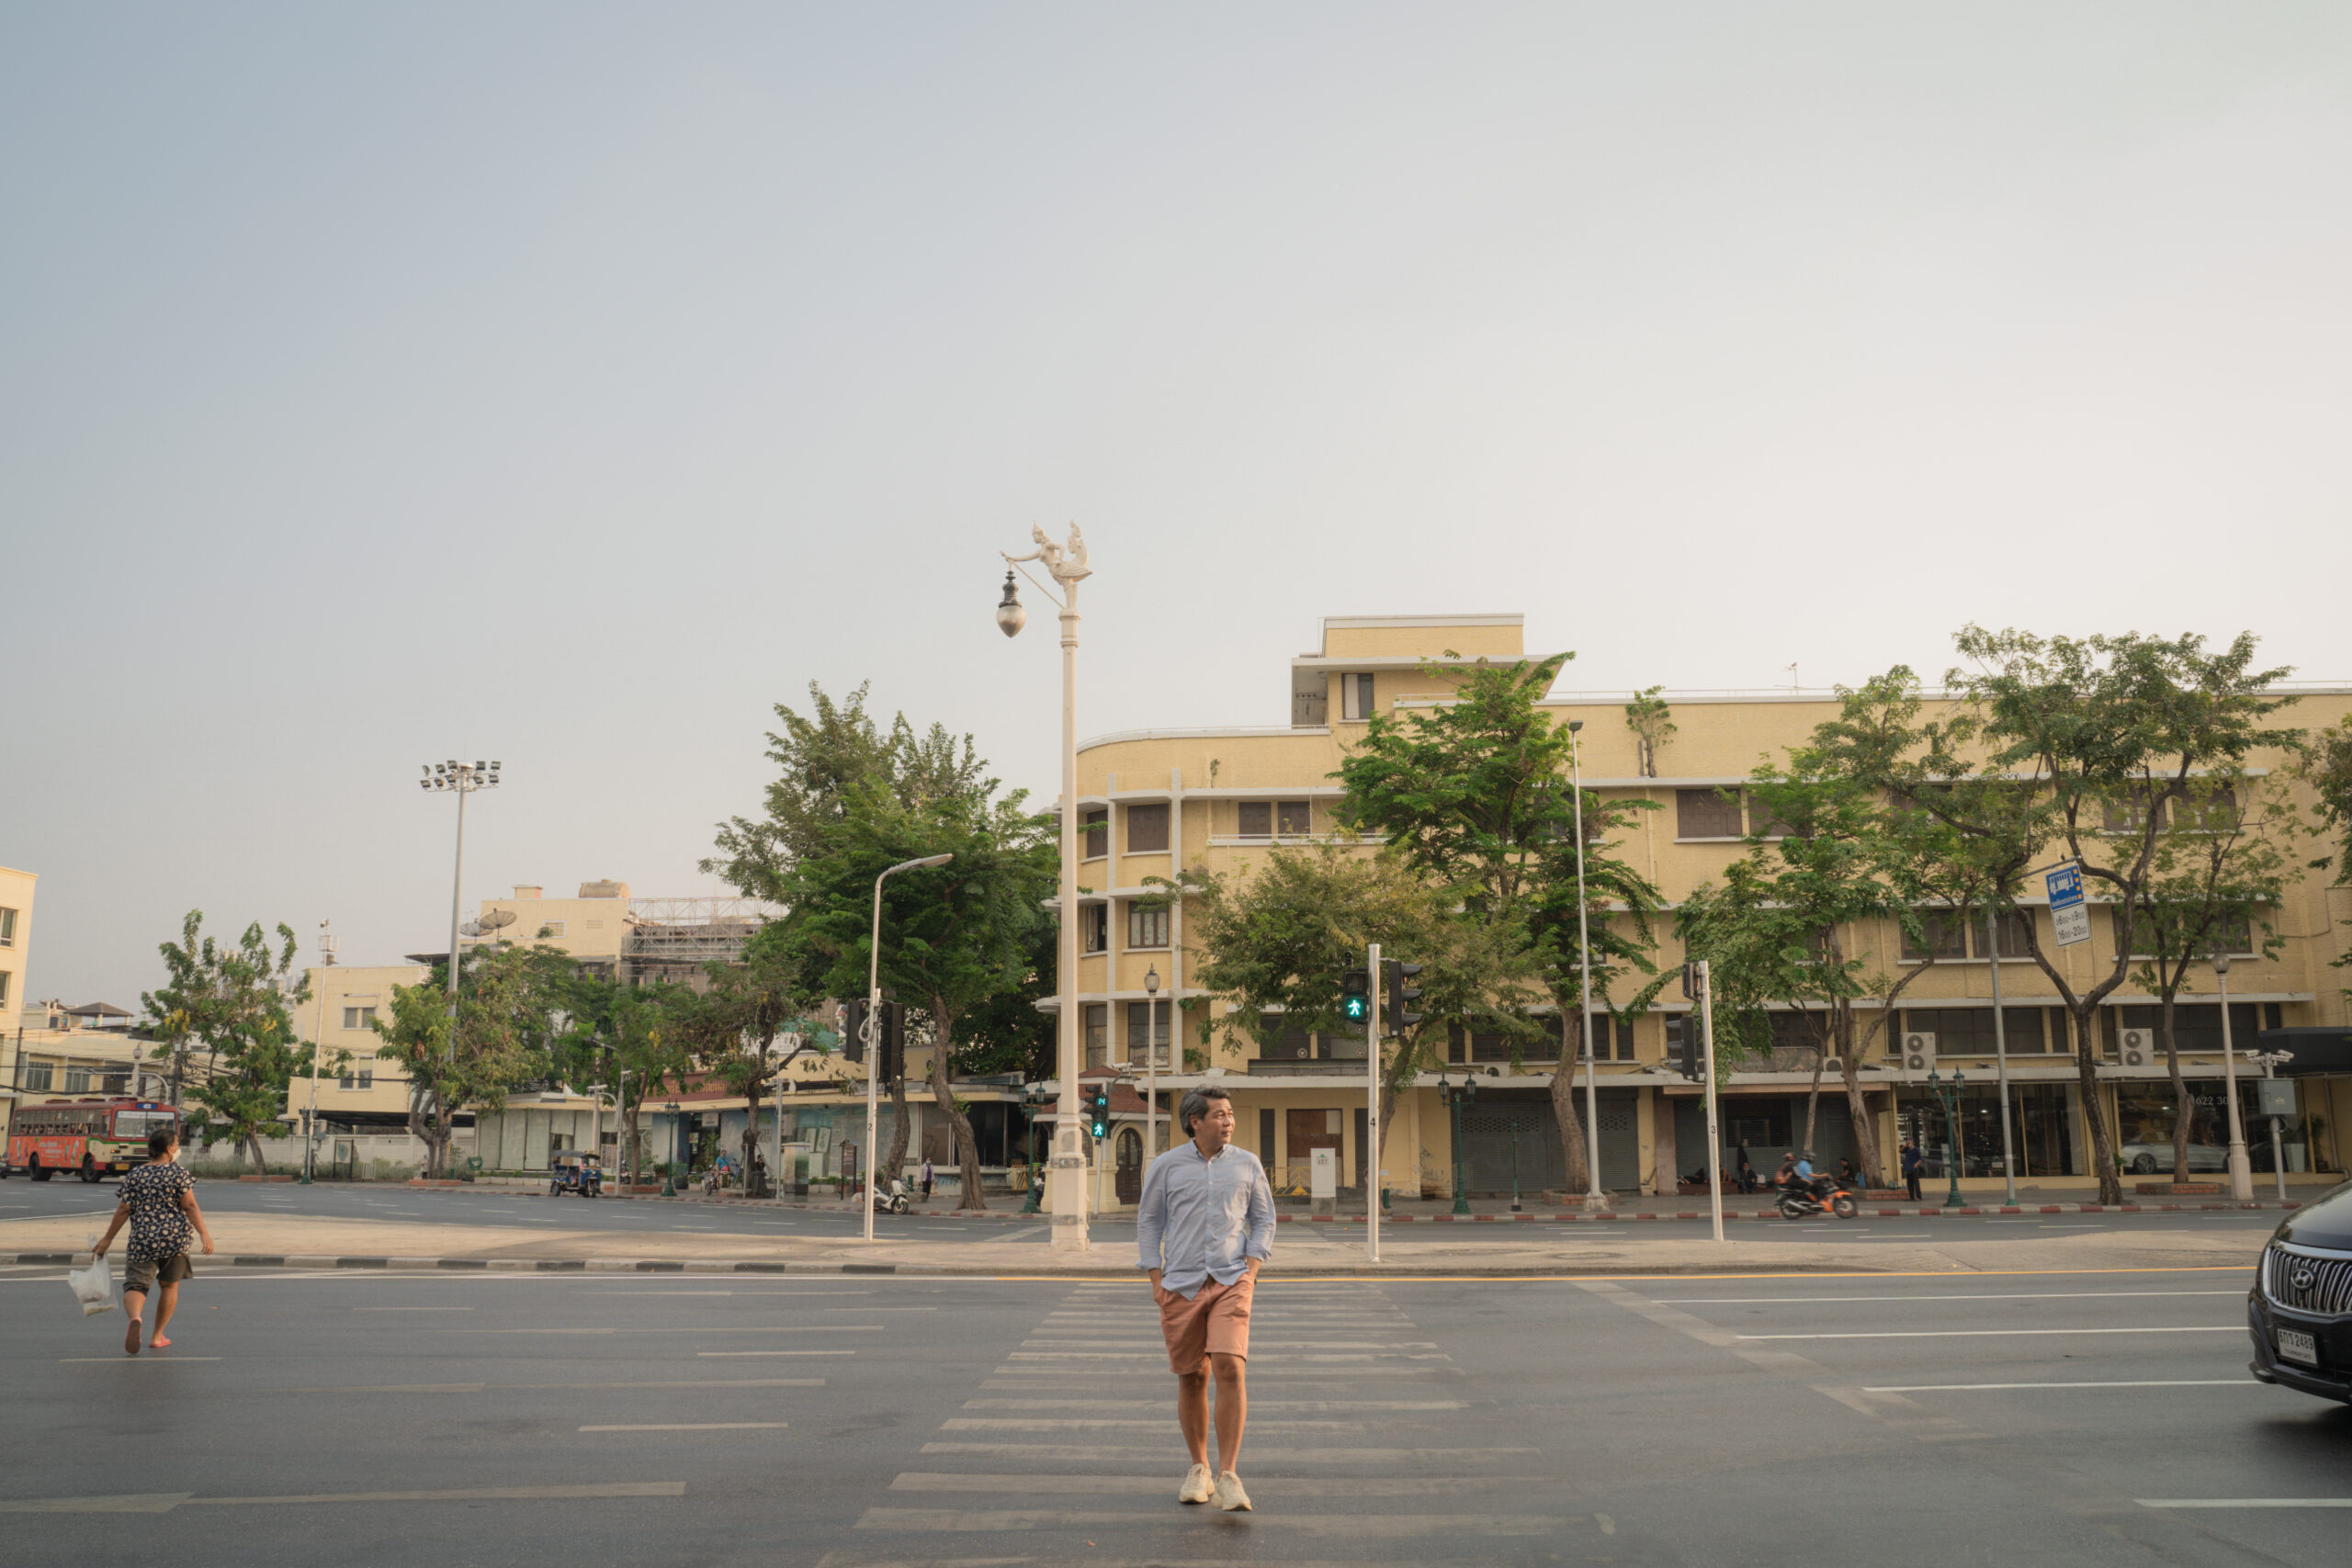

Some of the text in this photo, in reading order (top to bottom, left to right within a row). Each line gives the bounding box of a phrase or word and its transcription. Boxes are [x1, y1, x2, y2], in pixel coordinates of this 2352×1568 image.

[1098, 1098, 1106, 1106] 14
[1369, 1117, 1376, 1127] 4
[867, 1122, 873, 1132] 2
[1711, 1125, 1716, 1134] 3
